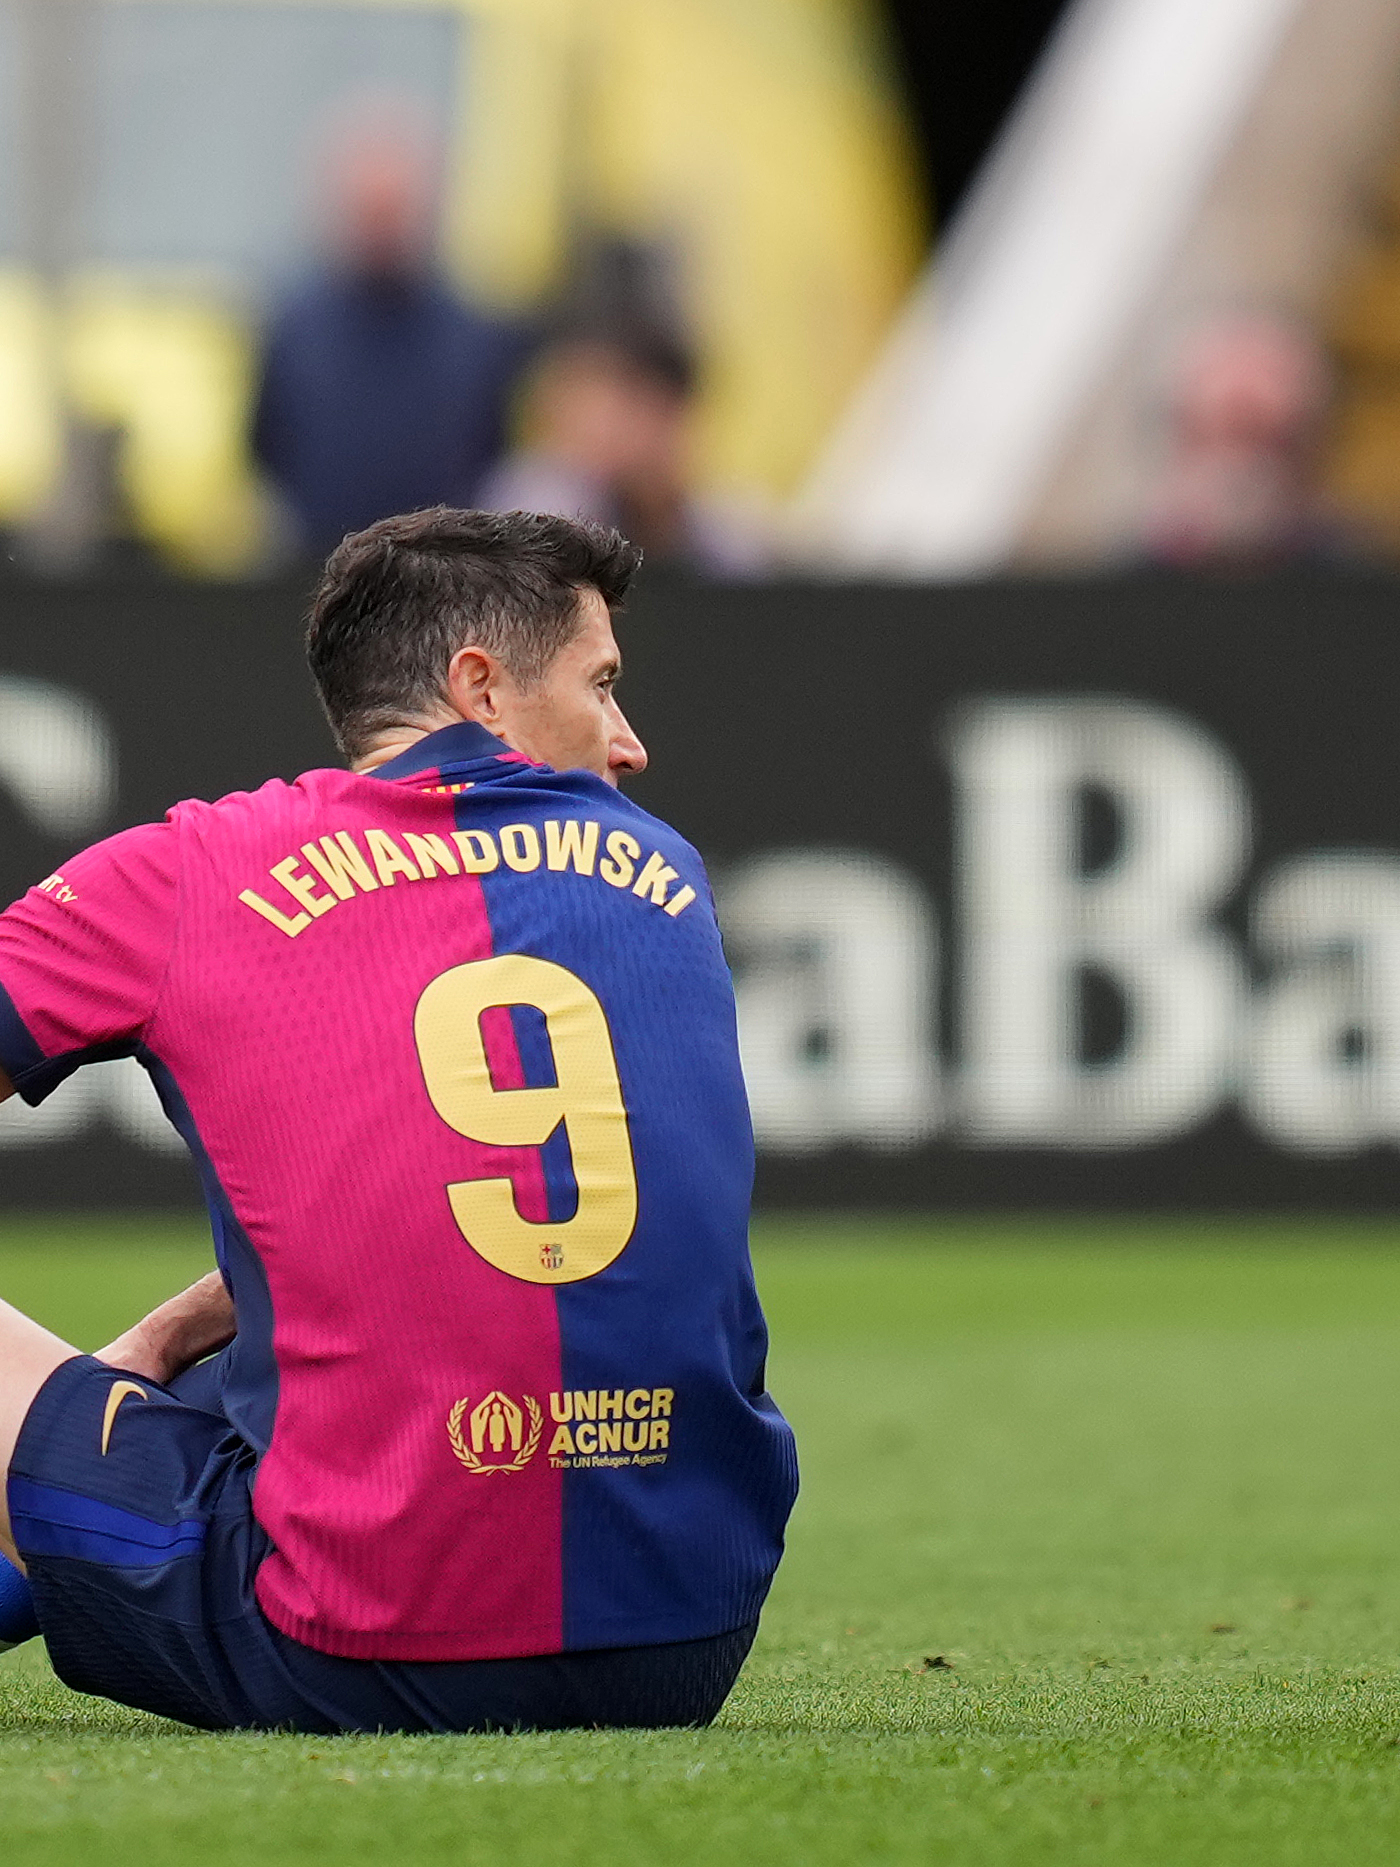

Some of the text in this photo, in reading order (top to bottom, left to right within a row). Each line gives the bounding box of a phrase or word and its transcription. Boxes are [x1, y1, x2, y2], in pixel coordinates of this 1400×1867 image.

[55, 885, 79, 902] tv
[238, 820, 696, 938] LEWANDOWSKI
[413, 953, 638, 1284] 9
[549, 1388, 674, 1422] UNHCR
[547, 1420, 669, 1454] ACNUR
[548, 1453, 668, 1469] The UN Refugee Agency
